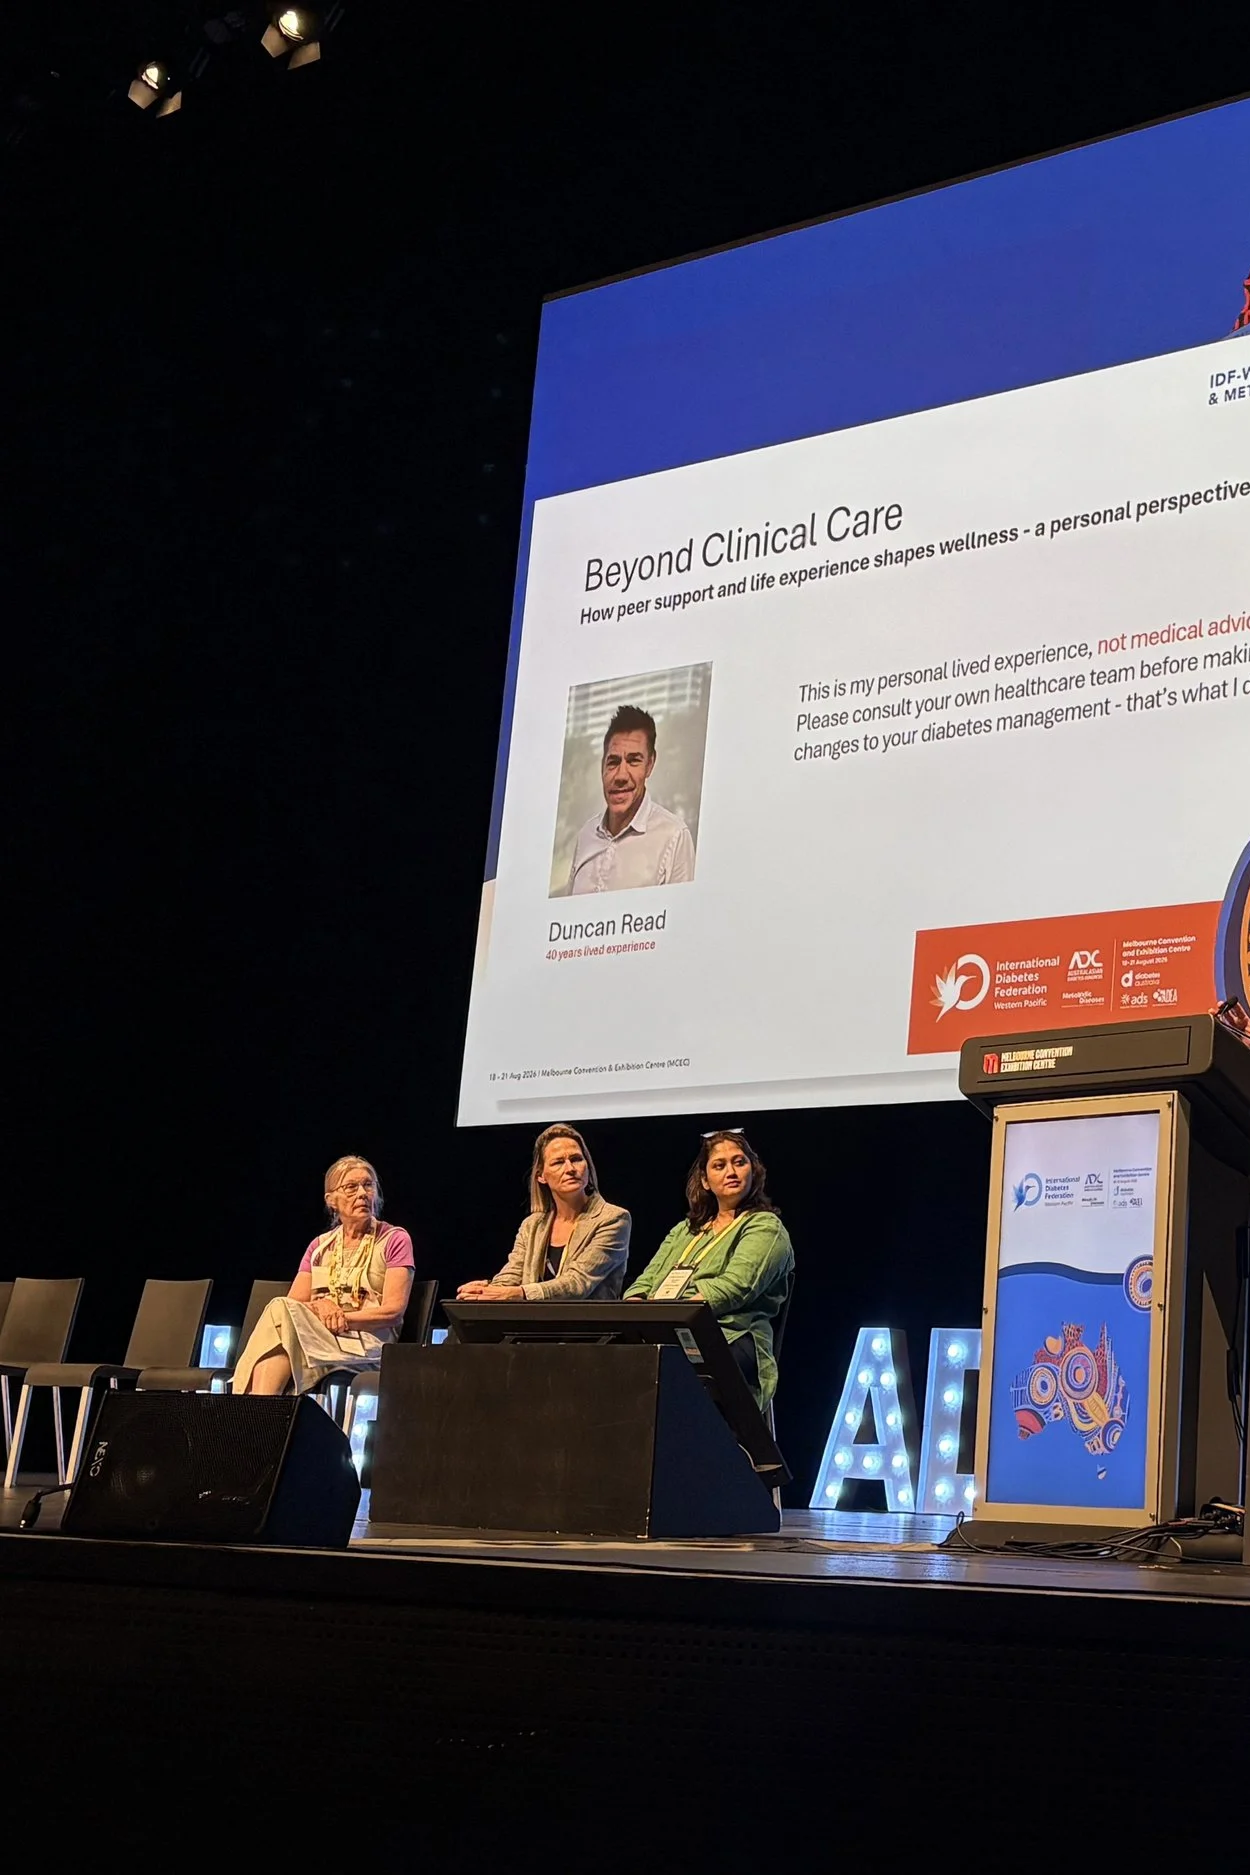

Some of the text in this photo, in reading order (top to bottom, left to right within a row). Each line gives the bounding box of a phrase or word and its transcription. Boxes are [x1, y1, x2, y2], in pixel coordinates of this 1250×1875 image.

[1208, 392, 1218, 405] &
[585, 503, 903, 592] Beyond Clinical Care
[580, 605, 615, 626] How
[617, 597, 652, 622] peer
[654, 585, 714, 612] support
[717, 577, 747, 600] and
[751, 572, 776, 592] life
[779, 557, 870, 587] experience
[874, 544, 935, 568] shapes
[940, 527, 1019, 555] wellness
[1035, 522, 1046, 537] a
[1050, 501, 1132, 539] personal
[799, 684, 831, 703] This
[834, 682, 847, 698] is
[850, 679, 875, 697] my
[877, 662, 949, 693] personal
[952, 654, 991, 678] lived
[995, 643, 1093, 673] experience,
[1098, 632, 1128, 654] not
[1131, 619, 1204, 649] medical
[797, 708, 849, 732] Please
[852, 699, 913, 724] consult
[915, 695, 952, 718] your
[955, 689, 990, 708] own
[995, 674, 1086, 701] healthcare
[1090, 666, 1135, 686] team
[1140, 656, 1199, 679] before
[794, 739, 860, 761] changes
[864, 732, 879, 751] to
[882, 730, 919, 753] your
[922, 719, 993, 742] diabetes
[997, 698, 1112, 731] management
[1182, 680, 1229, 704] what
[1233, 676, 1238, 697] I
[548, 909, 667, 943] Duncan Read
[1122, 935, 1196, 948] Melbourne Convention
[546, 940, 656, 962] 40 years lived experience
[1122, 944, 1192, 957] and Exhibition Centre
[996, 955, 1060, 971] International
[1068, 949, 1103, 970] ADC
[995, 971, 1040, 984] Diabetes
[994, 984, 1047, 998] Federation
[1130, 992, 1149, 1005] ads
[994, 998, 1047, 1010] Western Pacific
[1001, 1046, 1074, 1062] MELBOURNE CONVENTION
[509, 1071, 521, 1081] Aug
[522, 1070, 537, 1079] 2026
[541, 1067, 572, 1077] Melbourne
[573, 1064, 607, 1075] Convention
[608, 1063, 613, 1072] &
[614, 1062, 645, 1072] Exhibition
[645, 1060, 666, 1070] Centre
[1000, 1058, 1057, 1073] EXHIBITION CENTRE
[1045, 1176, 1081, 1184] International
[1045, 1184, 1069, 1192] Diabetes
[1044, 1192, 1074, 1200] Federation
